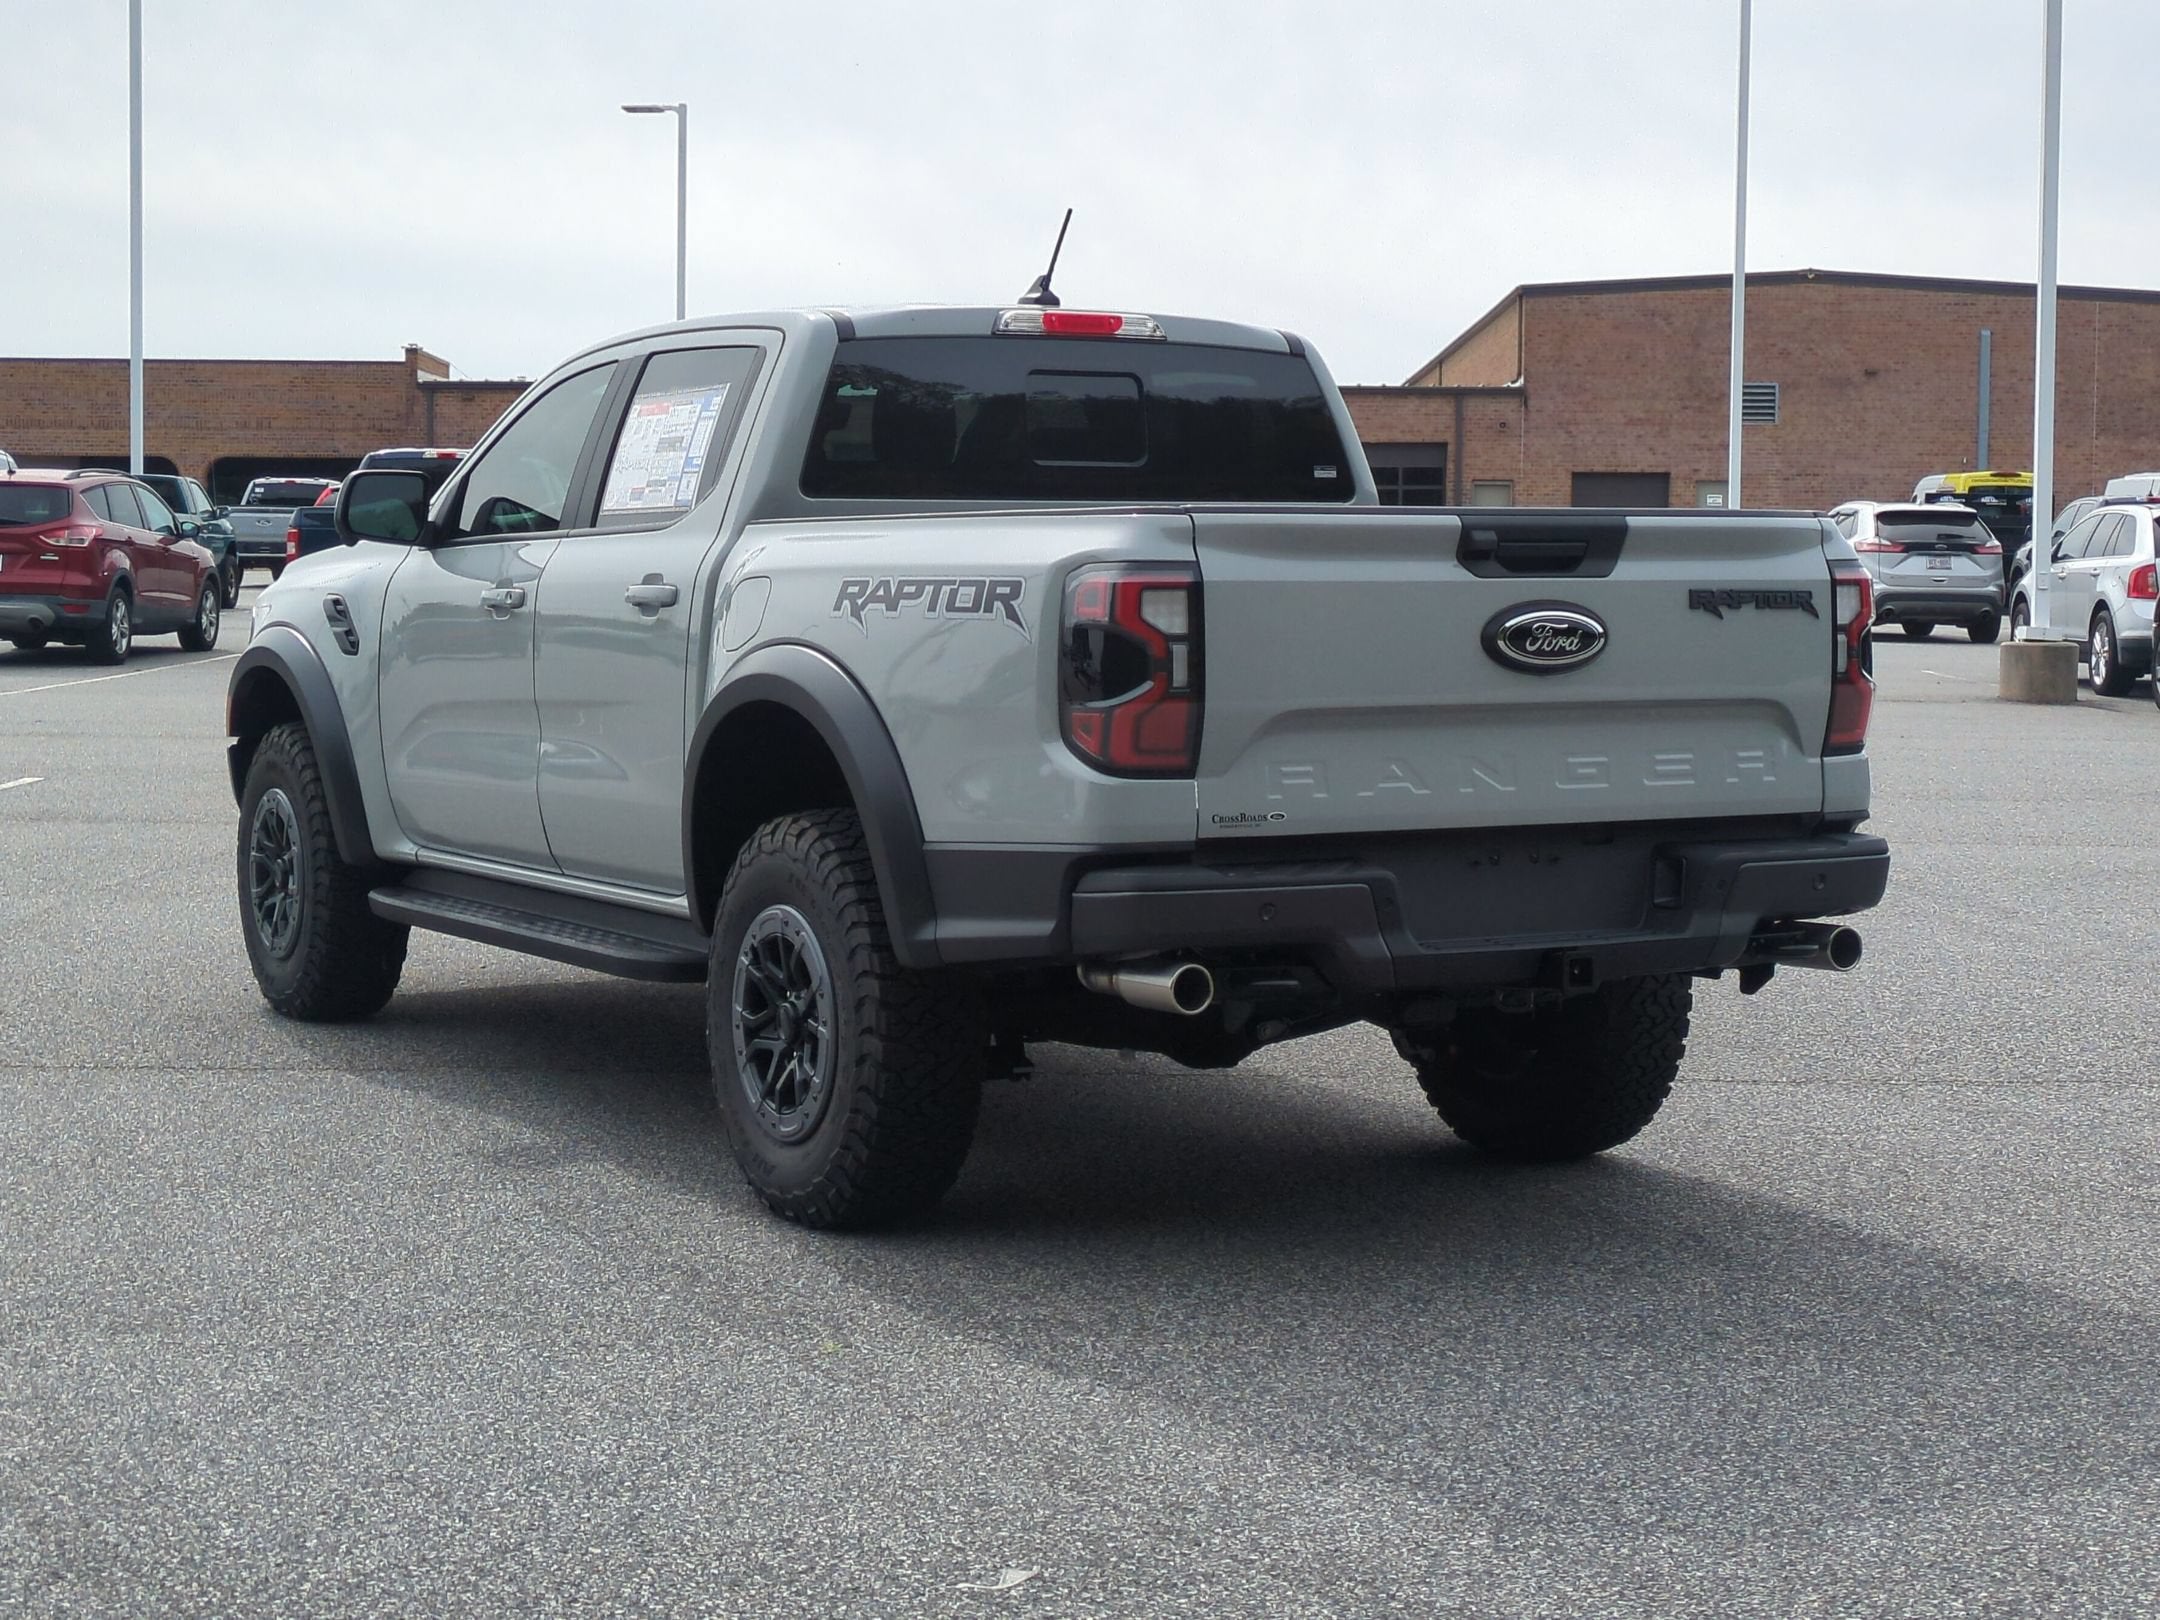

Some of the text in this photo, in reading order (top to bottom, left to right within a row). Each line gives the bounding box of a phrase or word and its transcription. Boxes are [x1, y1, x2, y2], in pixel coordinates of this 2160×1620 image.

[832, 577, 1031, 643] RAPTOR
[1689, 589, 1819, 620] RAPTOR
[1526, 622, 1582, 652] Ford
[1265, 746, 1777, 799] RANGER
